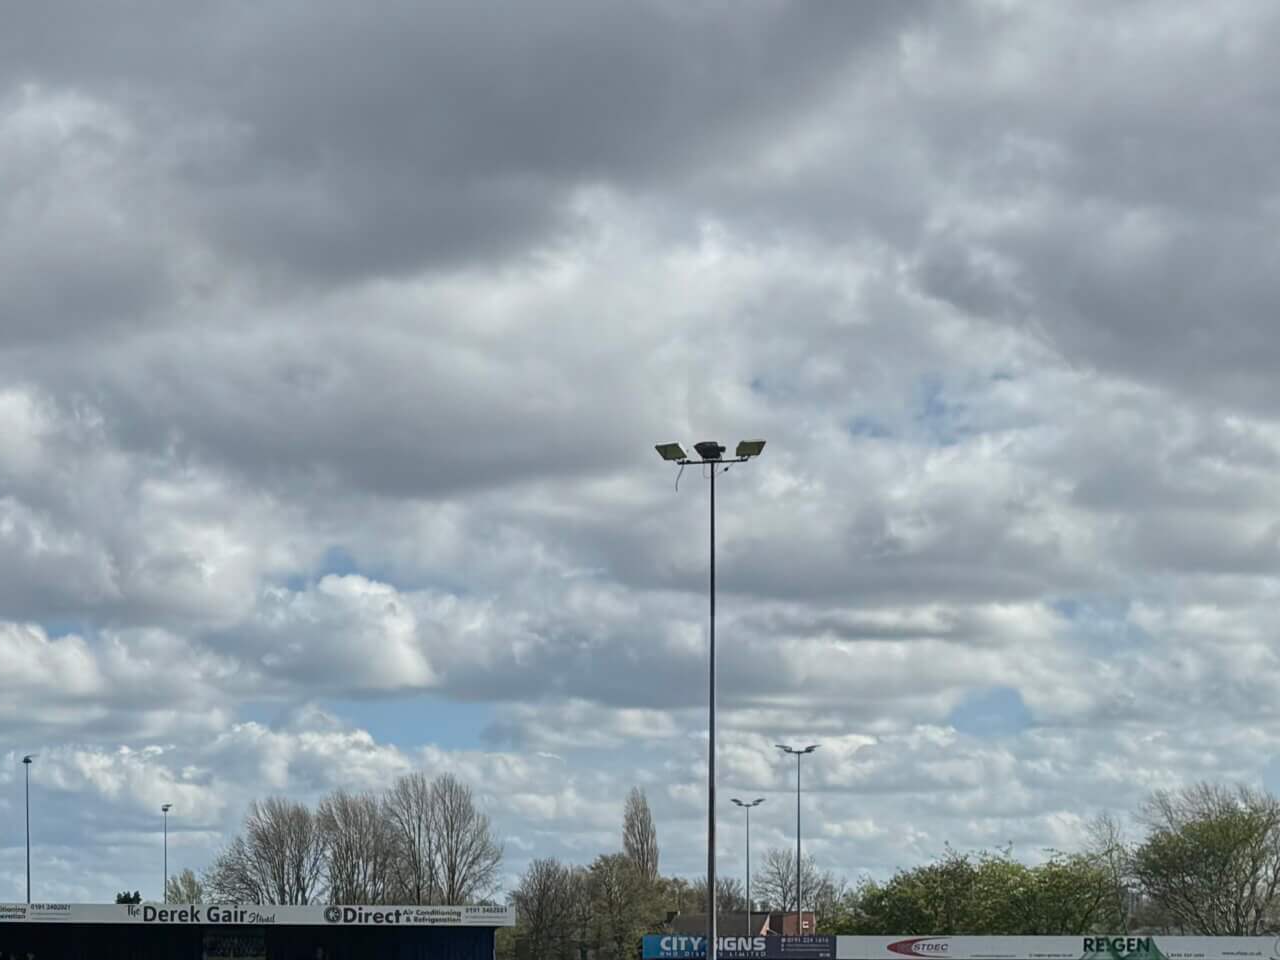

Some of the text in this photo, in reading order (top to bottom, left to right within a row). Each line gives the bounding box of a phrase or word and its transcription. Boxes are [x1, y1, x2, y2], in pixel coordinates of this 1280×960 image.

[144, 906, 201, 922] Derek
[207, 906, 248, 922] Gair
[343, 907, 402, 924] Direct
[415, 908, 462, 917] Conditioning
[660, 936, 703, 951] CITY
[716, 936, 767, 951] IGNS
